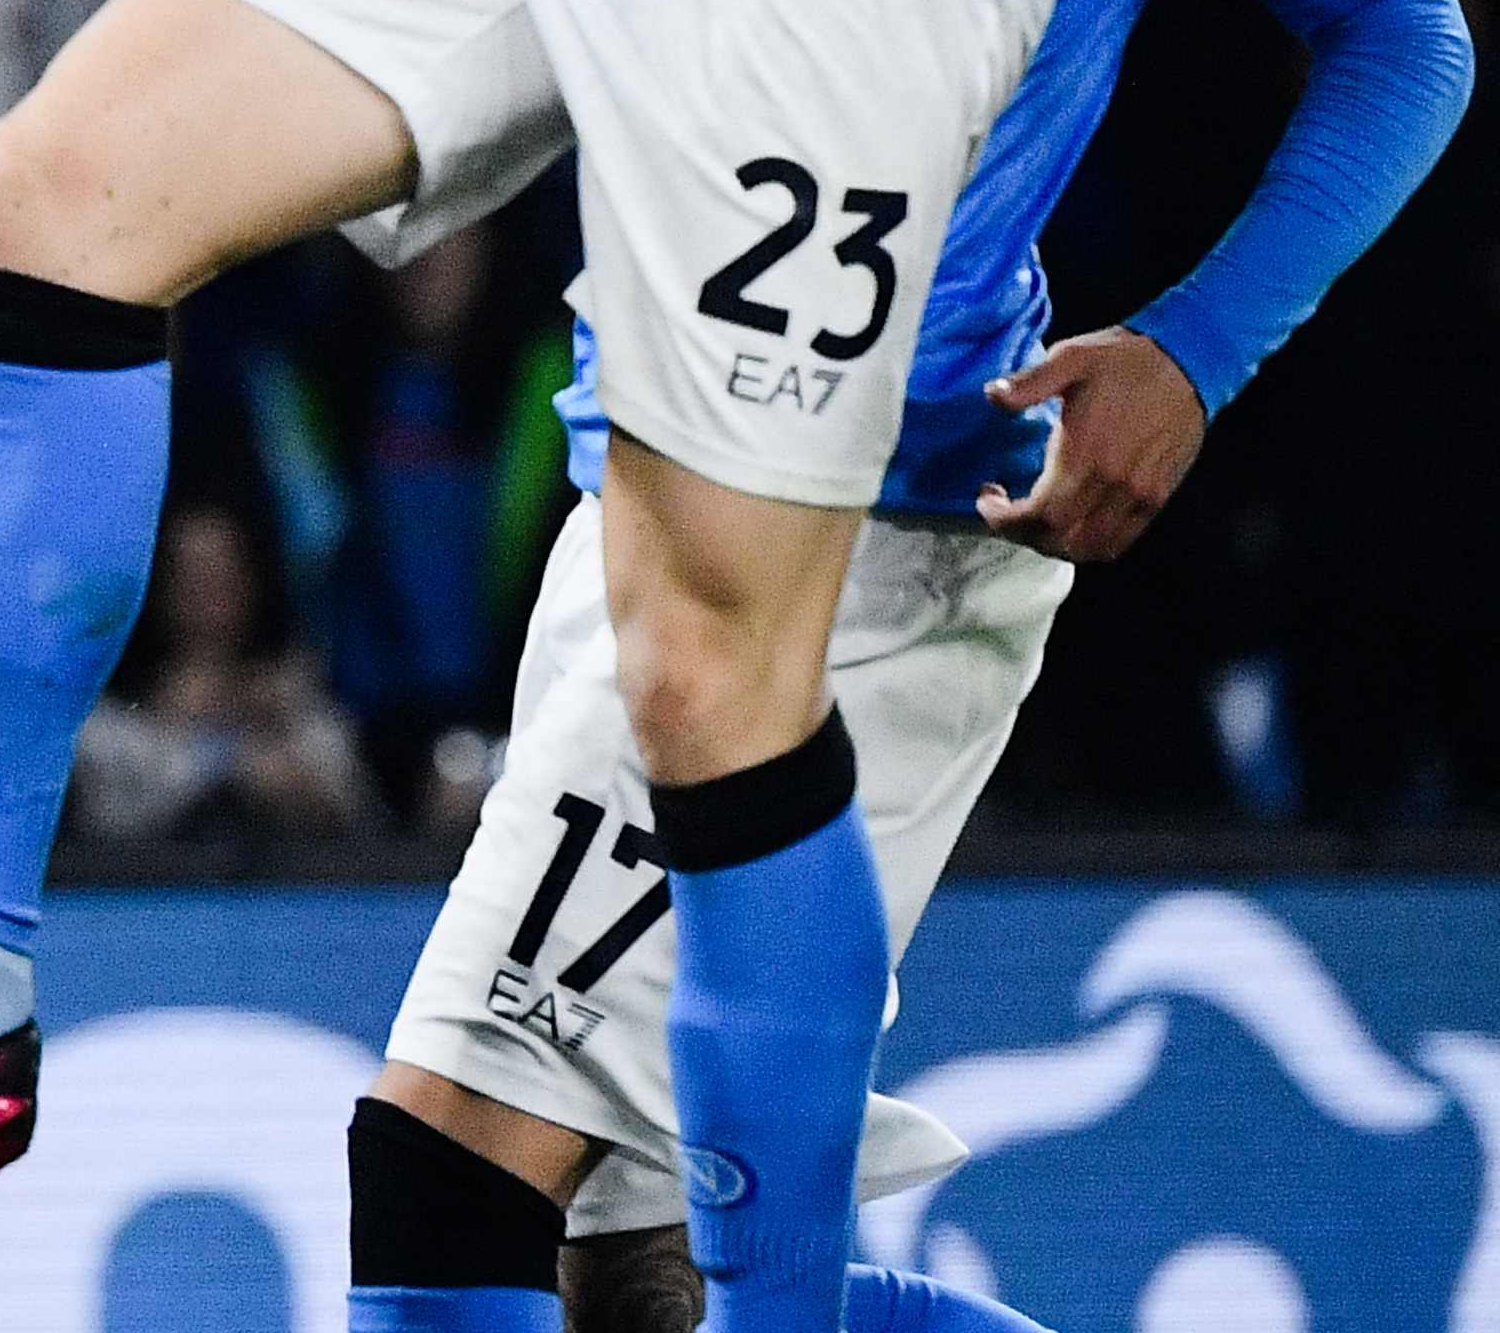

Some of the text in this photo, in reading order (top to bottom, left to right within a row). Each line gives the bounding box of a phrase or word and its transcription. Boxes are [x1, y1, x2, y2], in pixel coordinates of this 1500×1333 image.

[697, 156, 909, 362] 23
[726, 352, 844, 416] EA7
[507, 791, 673, 996] 17
[486, 968, 606, 1052] EA7
